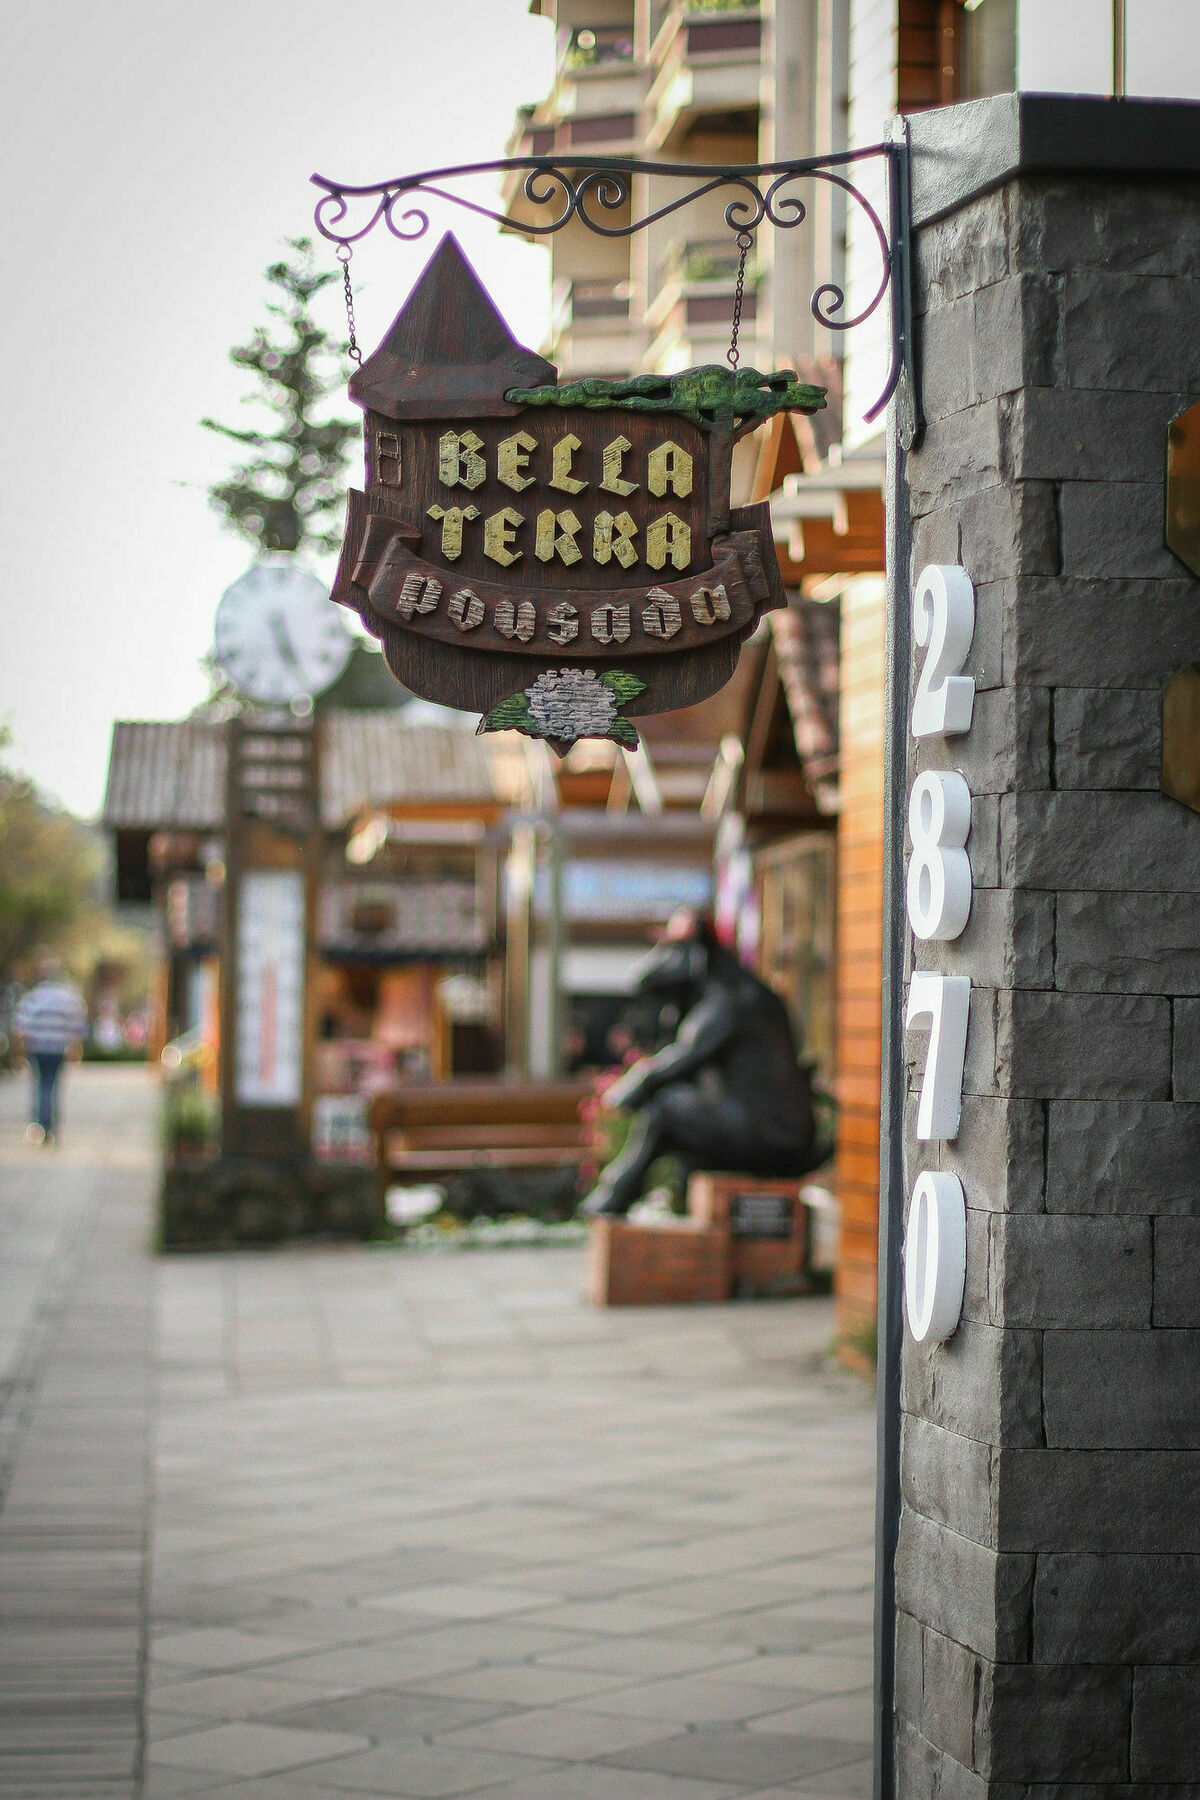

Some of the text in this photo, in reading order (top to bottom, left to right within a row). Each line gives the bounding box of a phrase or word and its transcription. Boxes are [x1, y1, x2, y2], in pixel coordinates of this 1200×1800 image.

[438, 429, 694, 499] BELLA
[426, 504, 692, 571] TERRA
[905, 564, 976, 1342] 2870
